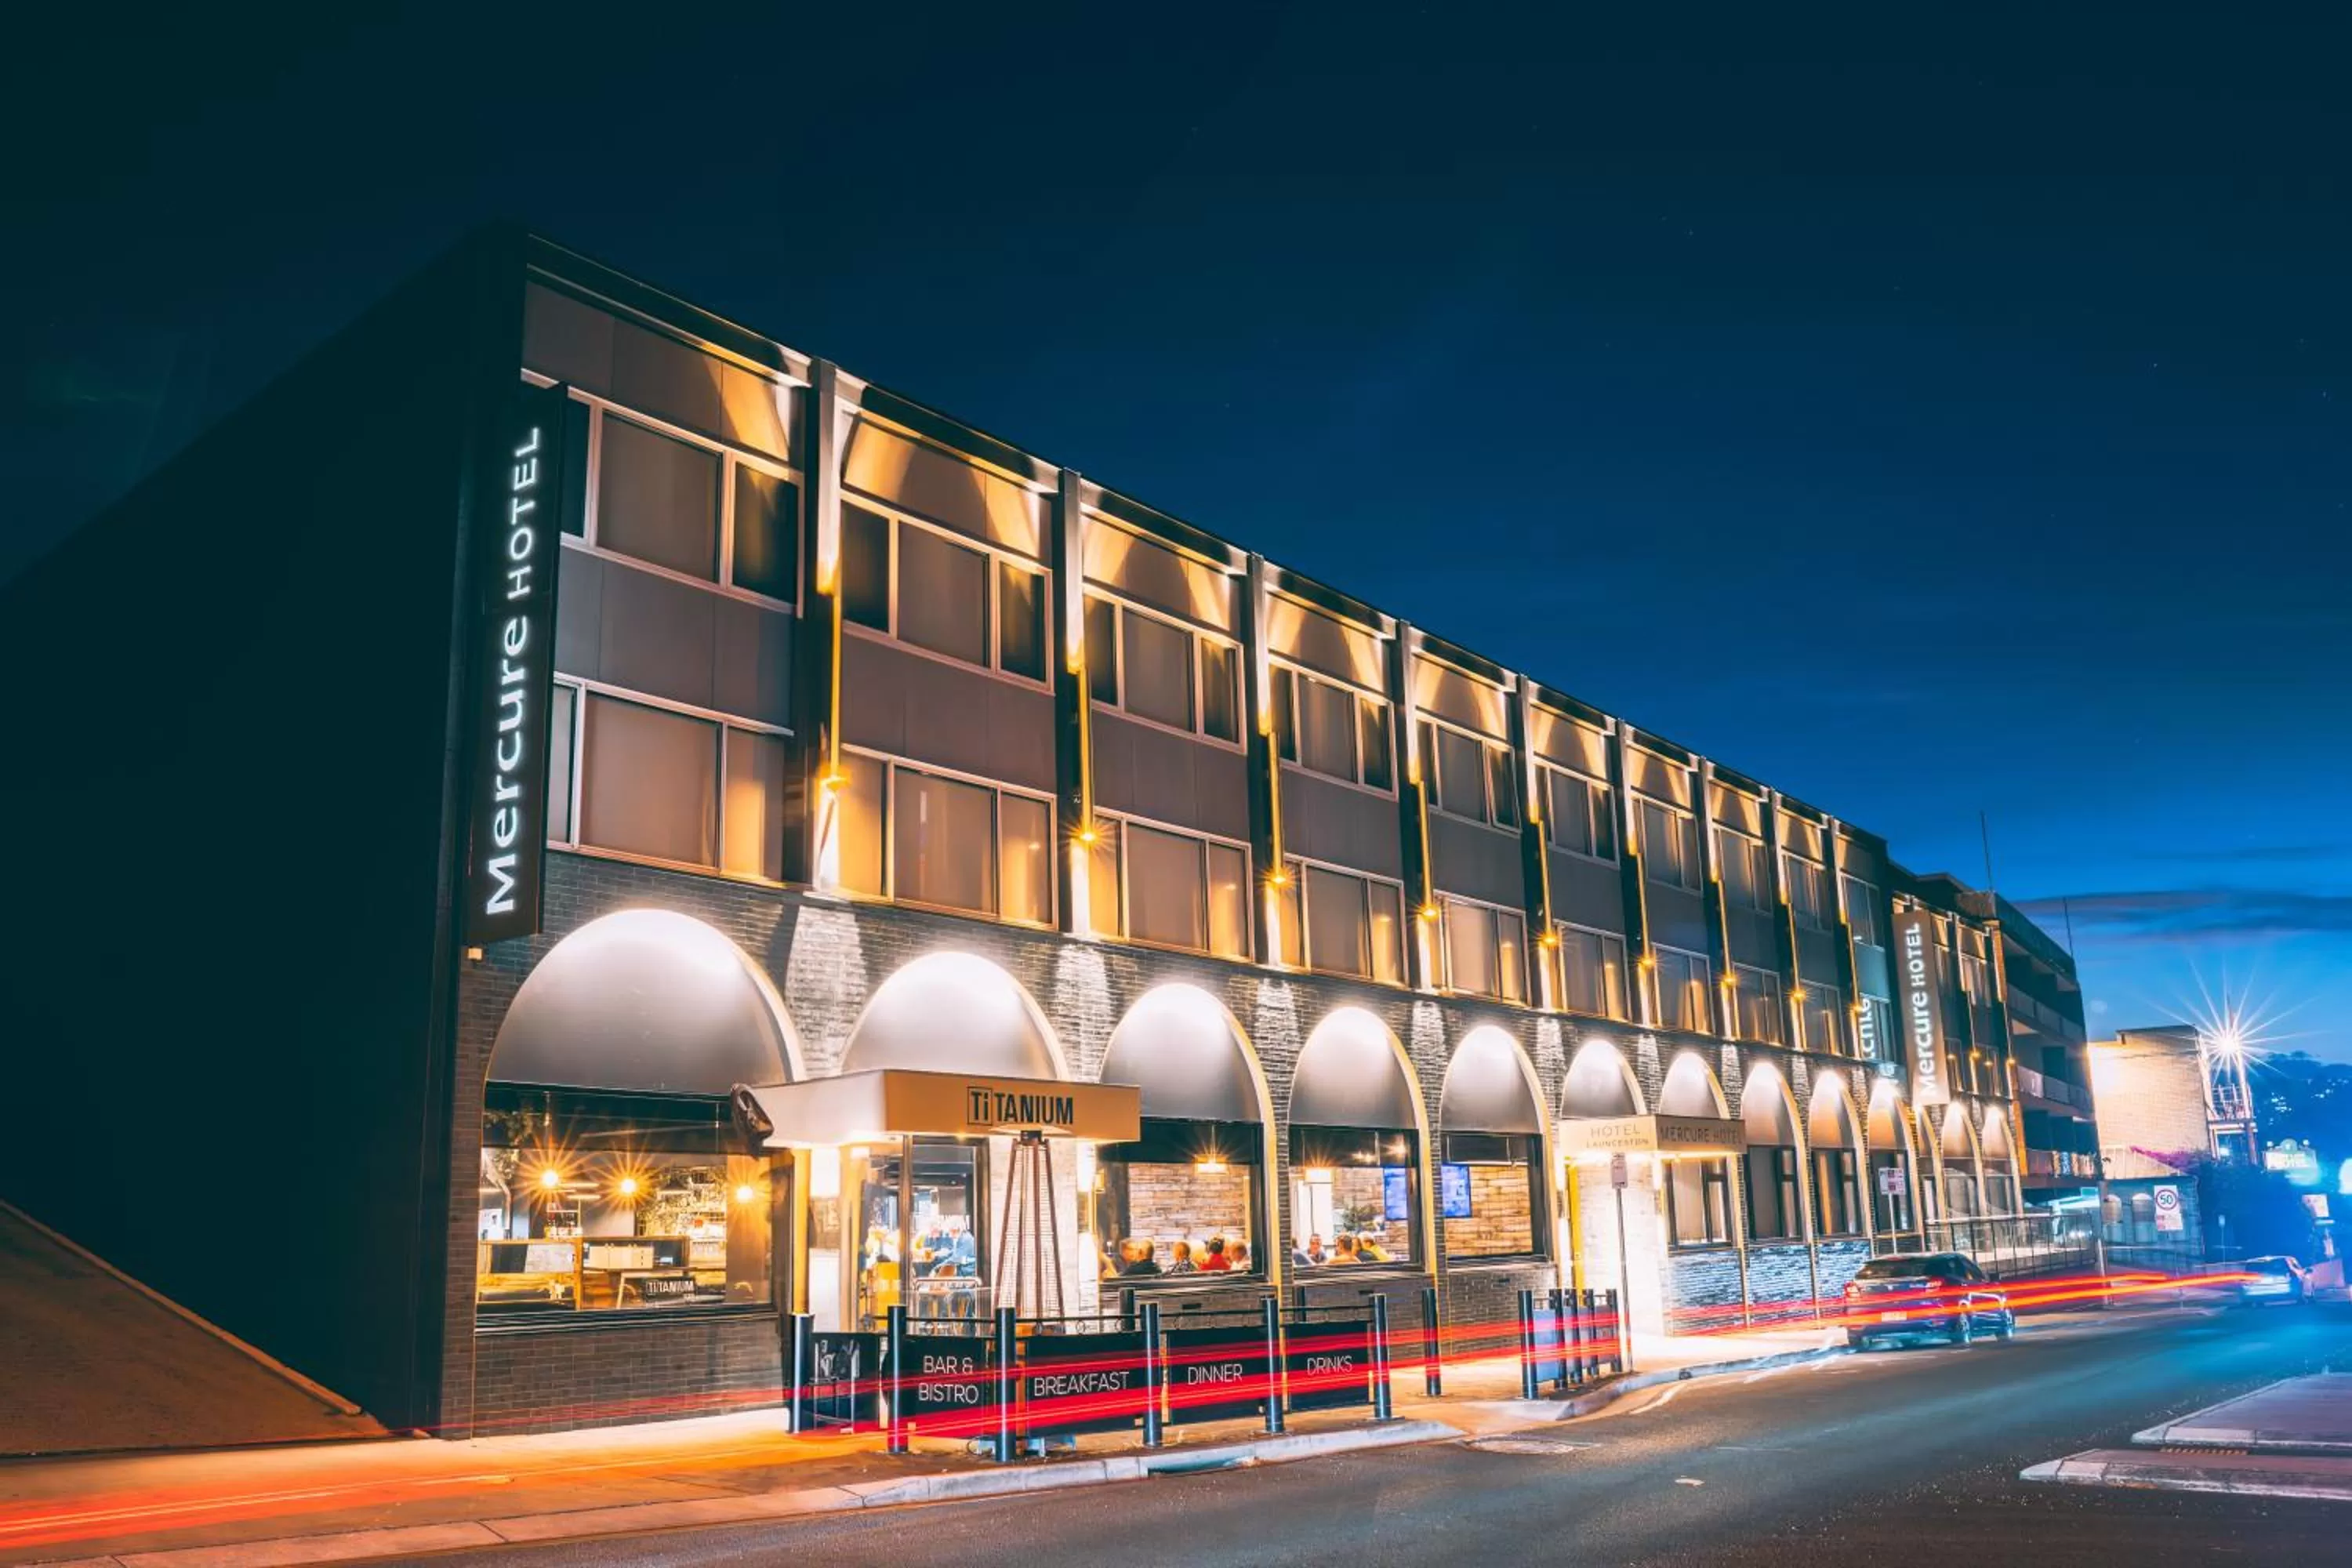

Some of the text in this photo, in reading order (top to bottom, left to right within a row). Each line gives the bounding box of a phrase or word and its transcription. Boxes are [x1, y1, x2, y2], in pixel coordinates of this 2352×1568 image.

[485, 426, 540, 915] Mercure HOTEL
[1904, 922, 1936, 1096] Mercure HOTEL
[1590, 1123, 1640, 1138] HOTEL
[1660, 1125, 1709, 1142] MERCURE
[2160, 1194, 2173, 1204] 50
[923, 1355, 973, 1374] BAR &
[1188, 1363, 1243, 1385] DINNER
[1306, 1355, 1352, 1376] DRINKS
[918, 1382, 979, 1404] BISTRO
[1034, 1371, 1130, 1396] BREAKFAST
